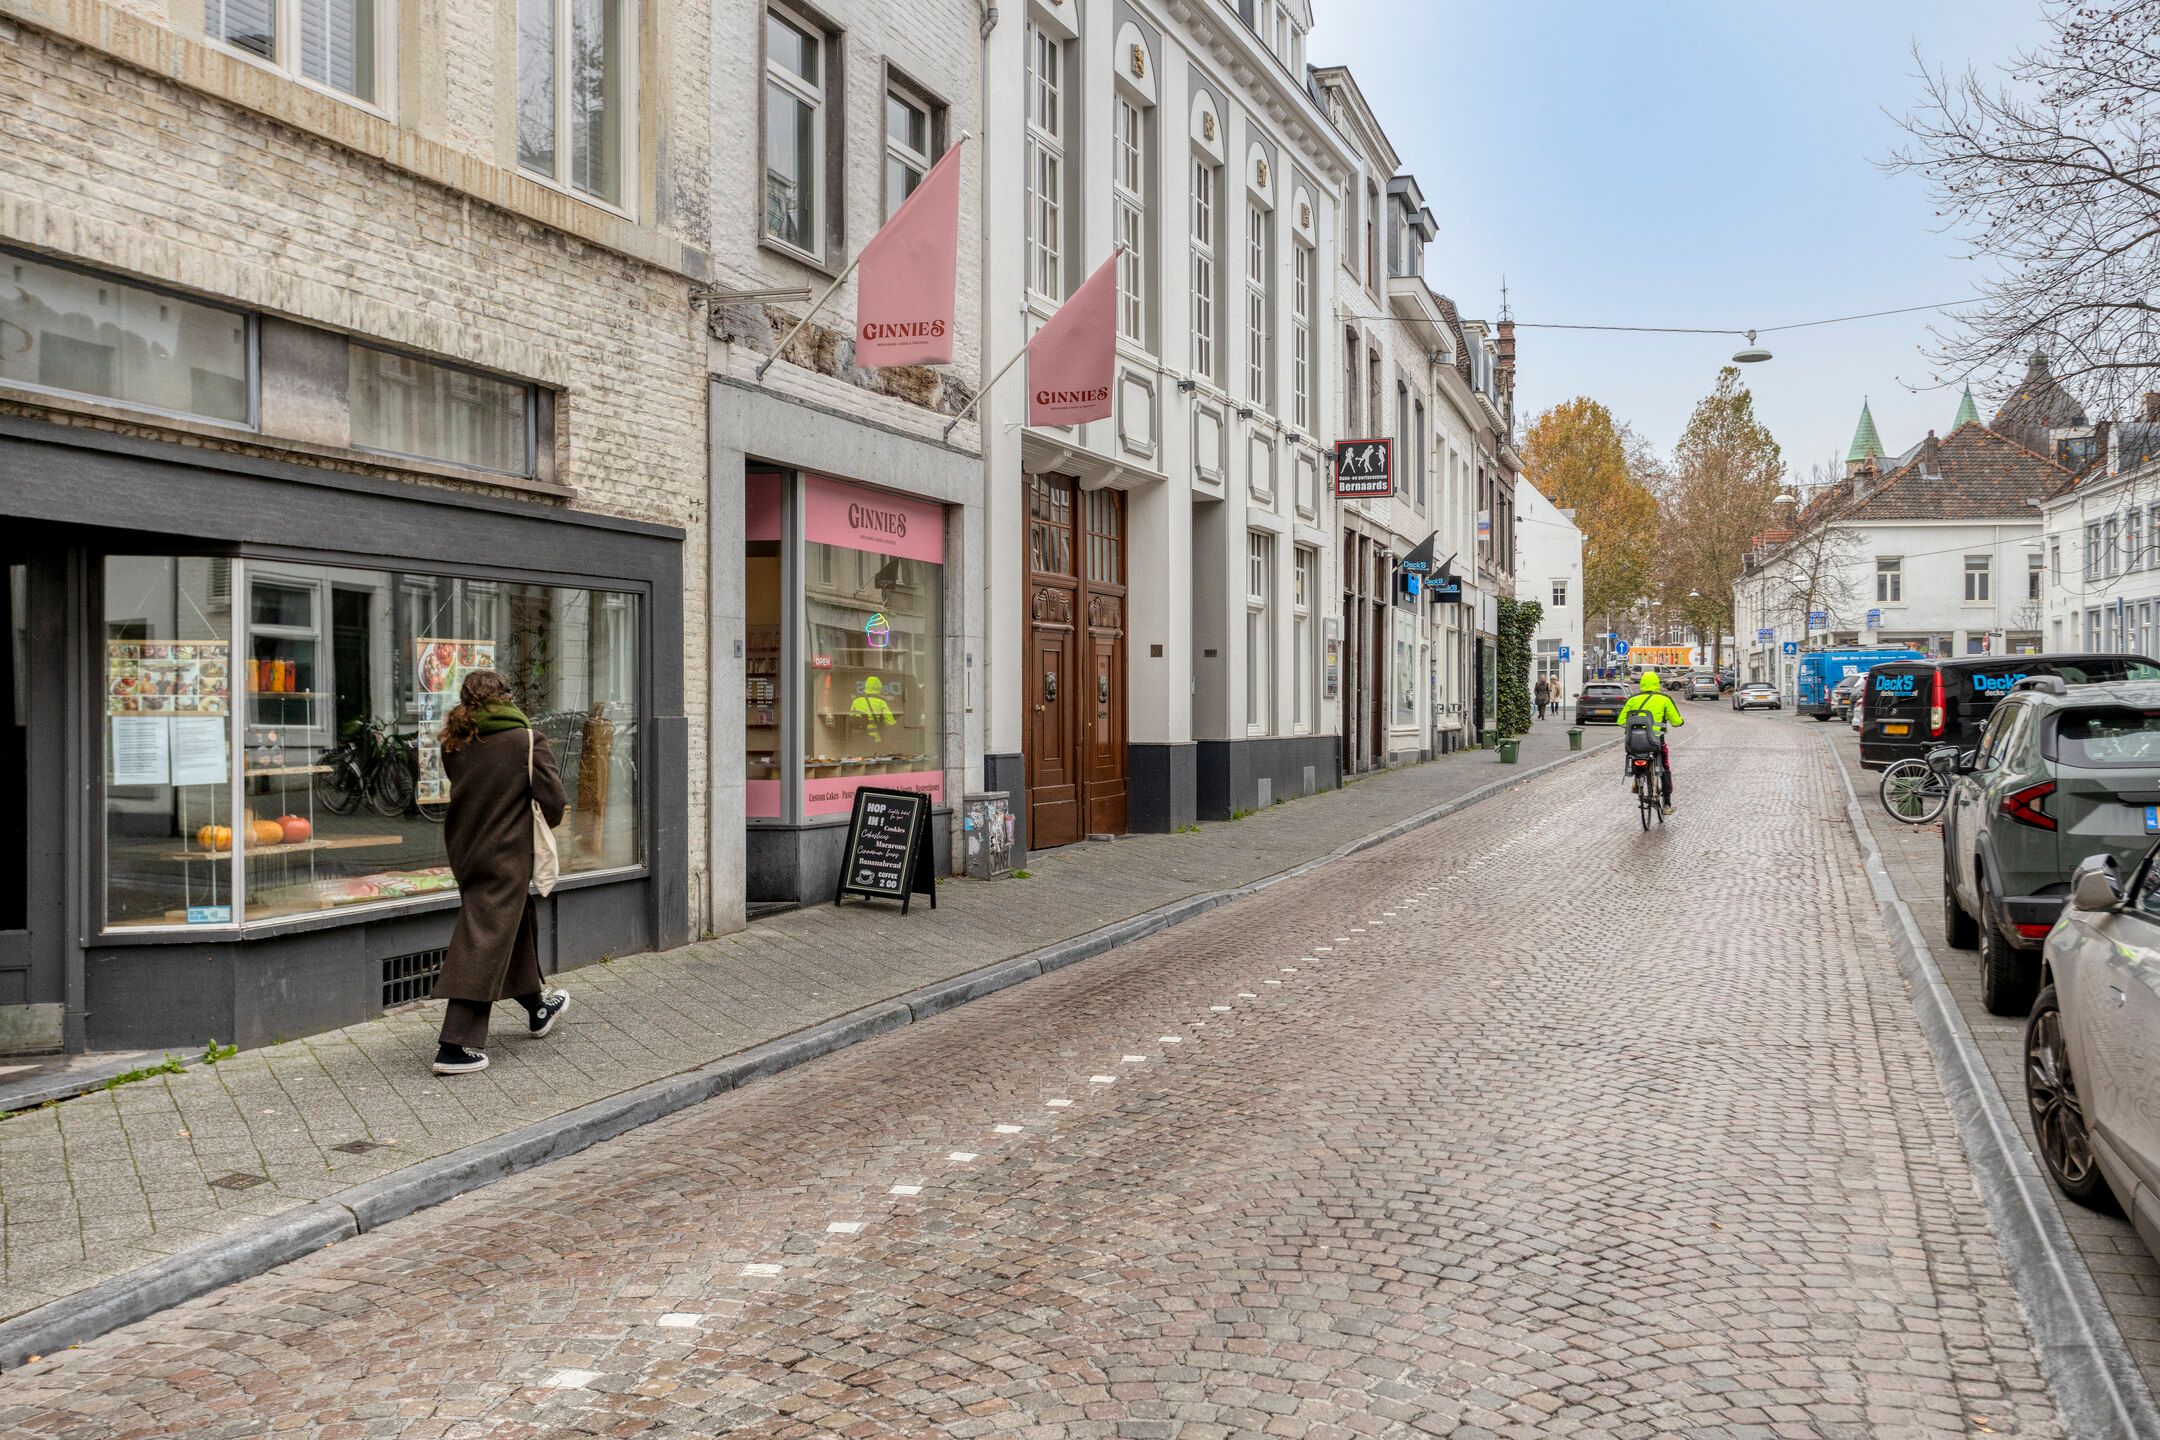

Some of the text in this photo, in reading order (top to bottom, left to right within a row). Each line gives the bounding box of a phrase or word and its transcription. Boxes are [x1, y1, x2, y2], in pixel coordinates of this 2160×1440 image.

[863, 319, 946, 340] GINNIES
[1036, 387, 1108, 405] GINNIES
[1339, 481, 1388, 491] Bernaards
[848, 503, 907, 538] GINNIES
[1561, 648, 1567, 656] P
[815, 657, 831, 666] OPEN
[826, 792, 839, 801] Cakes
[867, 803, 887, 813] HOP
[868, 816, 879, 826] IN
[884, 825, 905, 833] Cookies
[876, 841, 906, 850] Macarons
[859, 857, 902, 869] Bananabread
[878, 872, 899, 880] COFFEE
[879, 879, 897, 888] 2 GO
